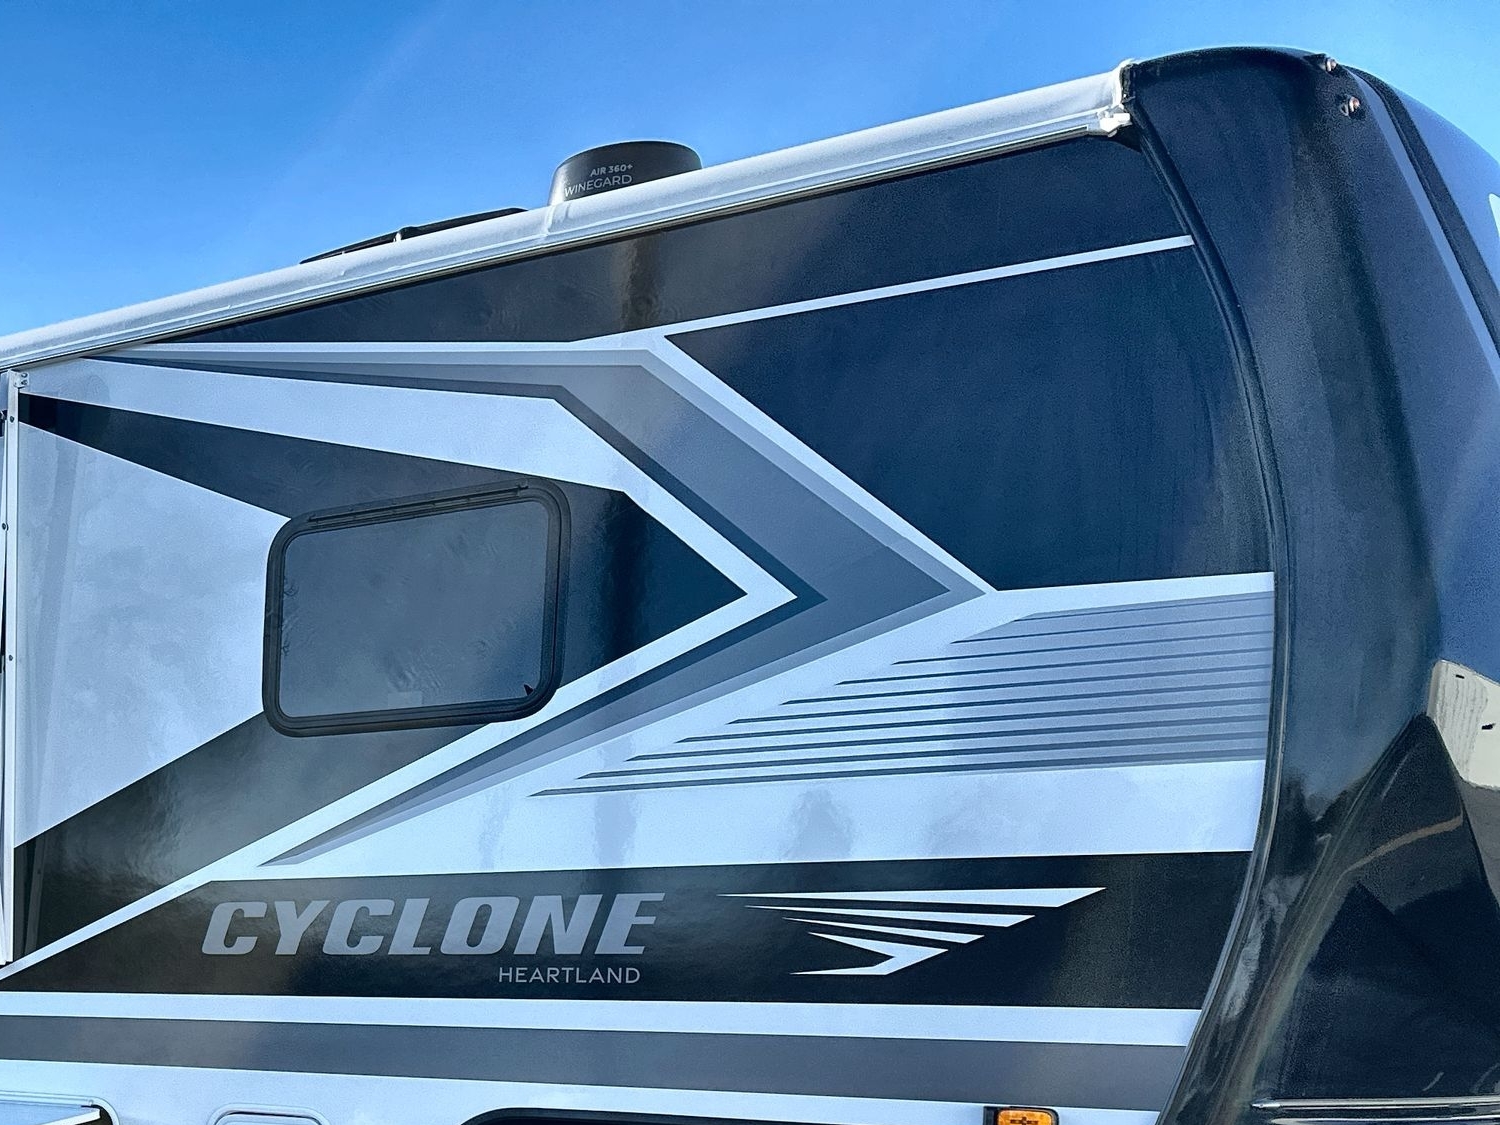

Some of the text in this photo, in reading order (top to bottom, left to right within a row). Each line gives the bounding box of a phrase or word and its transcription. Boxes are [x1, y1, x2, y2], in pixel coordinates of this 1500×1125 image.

[590, 167, 606, 177] AIR
[564, 174, 633, 197] WINEGARD
[201, 892, 665, 956] CYCLONE
[498, 966, 641, 985] HEARTLAND
